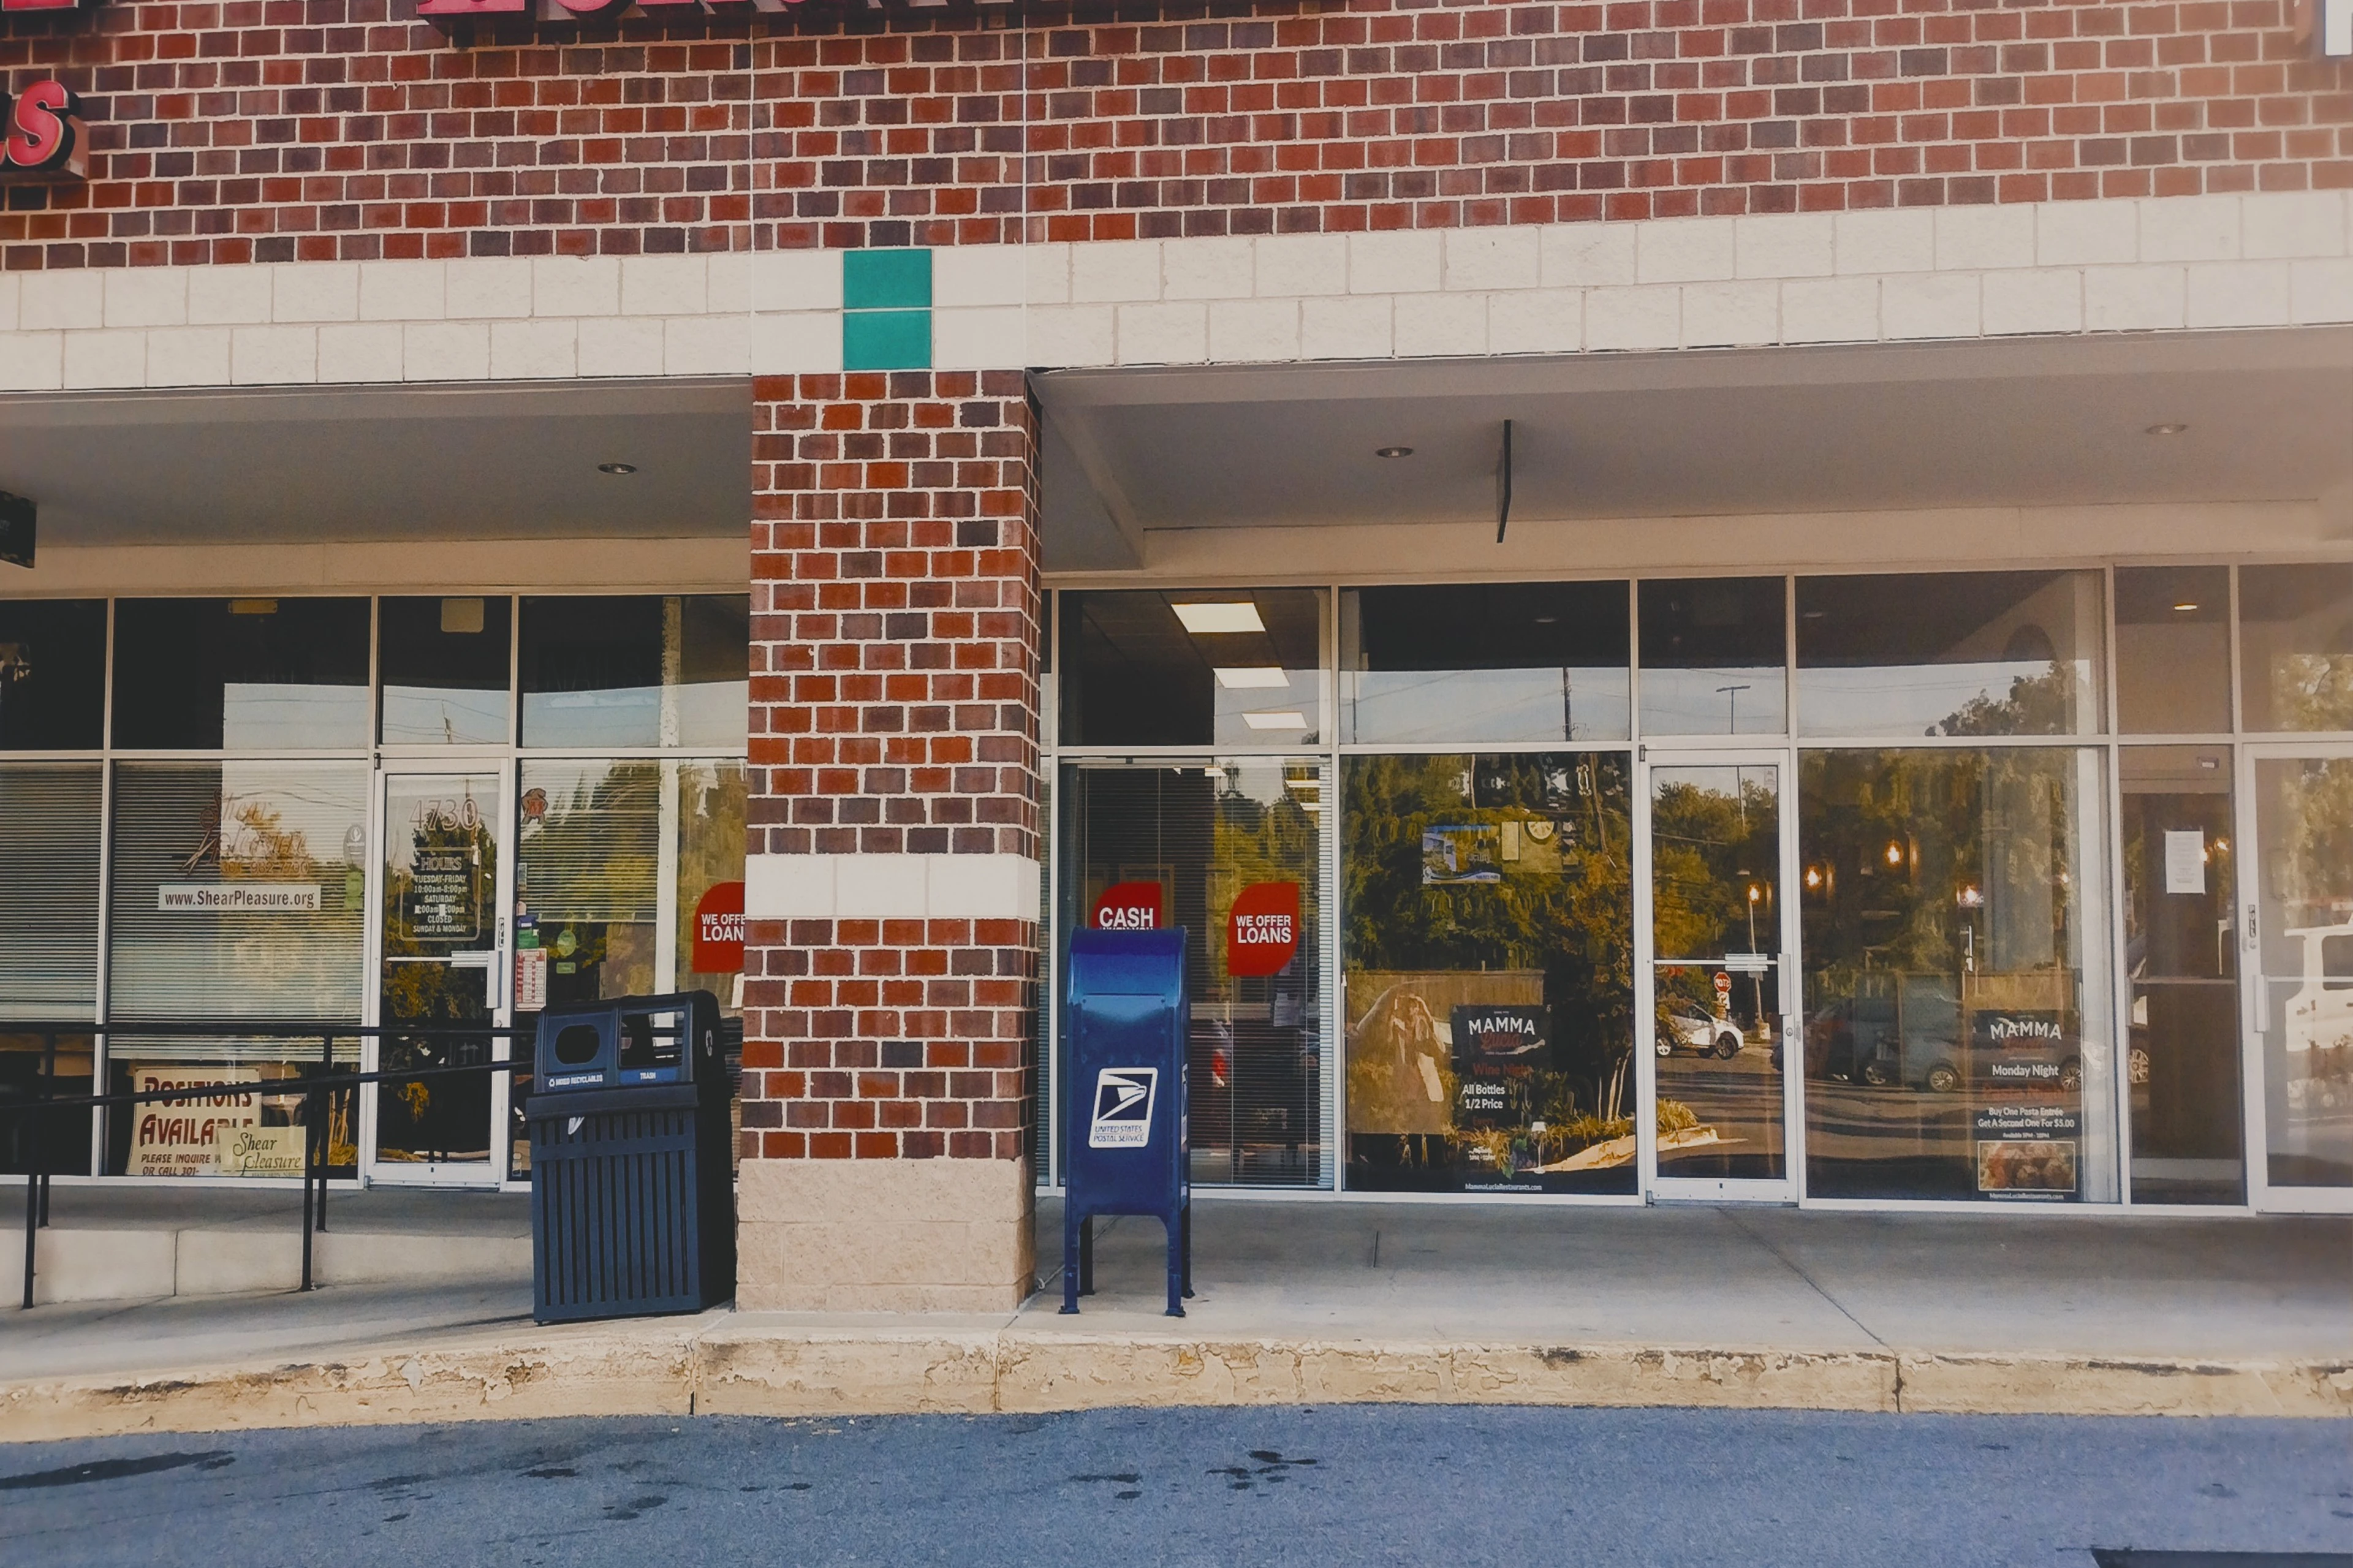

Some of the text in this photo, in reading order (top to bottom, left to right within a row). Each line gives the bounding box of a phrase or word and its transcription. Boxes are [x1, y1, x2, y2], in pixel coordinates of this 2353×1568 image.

[409, 798, 479, 831] 4730
[421, 857, 462, 871] HOURS
[165, 890, 314, 909] www.ShearPleasure.org
[424, 895, 457, 903] SATURDAY
[428, 915, 452, 923] CLOSED
[702, 914, 746, 925] WE OFFE
[1099, 907, 1154, 928] CASH
[1236, 915, 1291, 926] WE OFFER
[702, 926, 745, 941] LOAN
[1237, 928, 1292, 944] LOANS
[1468, 1017, 1536, 1036] MAMMA
[1990, 1021, 2062, 1040] MAMMA
[1992, 1064, 2059, 1078] Monday Night
[1463, 1083, 1505, 1095] All Bottles
[1465, 1098, 1503, 1110] 1/2 Price
[1988, 1107, 2003, 1117] Buy
[2003, 1107, 2018, 1116] One
[2020, 1107, 2039, 1116] Pasta
[1977, 1119, 1991, 1127] Get
[1991, 1119, 1998, 1127] A
[1998, 1118, 2024, 1127] Second
[2025, 1119, 2040, 1127] One
[2054, 1119, 2075, 1128] $5.00
[1093, 1134, 1117, 1142] POSTAL
[233, 1132, 277, 1157] Shear
[140, 1154, 172, 1164] PLEASE
[175, 1154, 211, 1164] INQUIRE
[142, 1167, 155, 1175] OR
[158, 1167, 179, 1175] CALL
